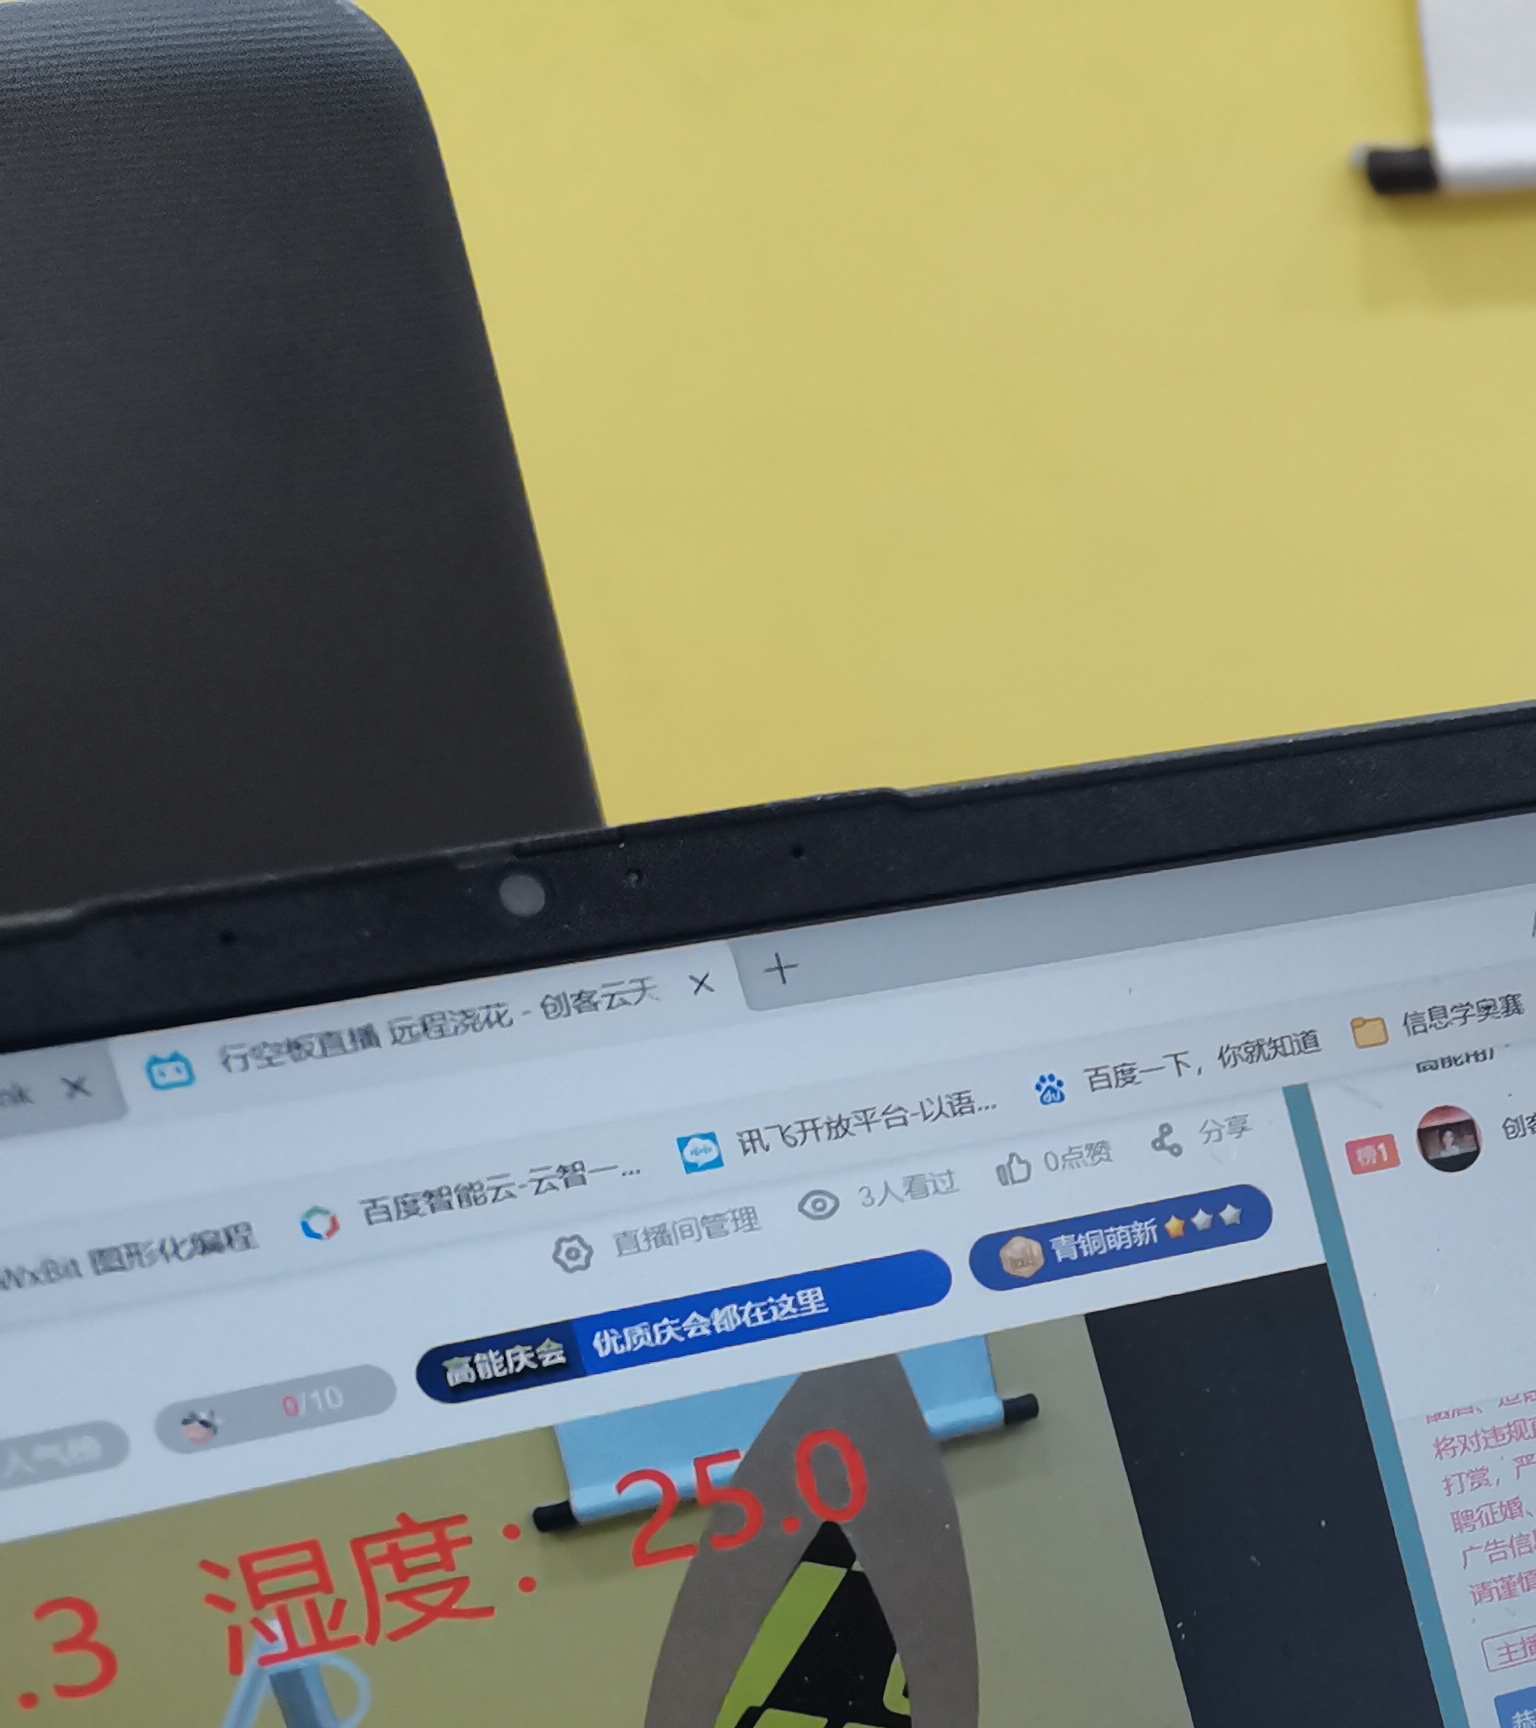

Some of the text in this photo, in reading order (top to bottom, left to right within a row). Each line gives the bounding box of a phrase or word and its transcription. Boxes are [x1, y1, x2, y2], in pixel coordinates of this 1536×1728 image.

[541, 976, 659, 1022] 创客云天
[1402, 993, 1525, 1038] 信息学奥赛
[1198, 1113, 1253, 1145] 分享
[859, 1169, 960, 1208] 3人看过
[613, 1204, 761, 1259] 直播间管理
[1052, 1218, 1159, 1263] 青铜萌新
[617, 1429, 869, 1567] 25.0
